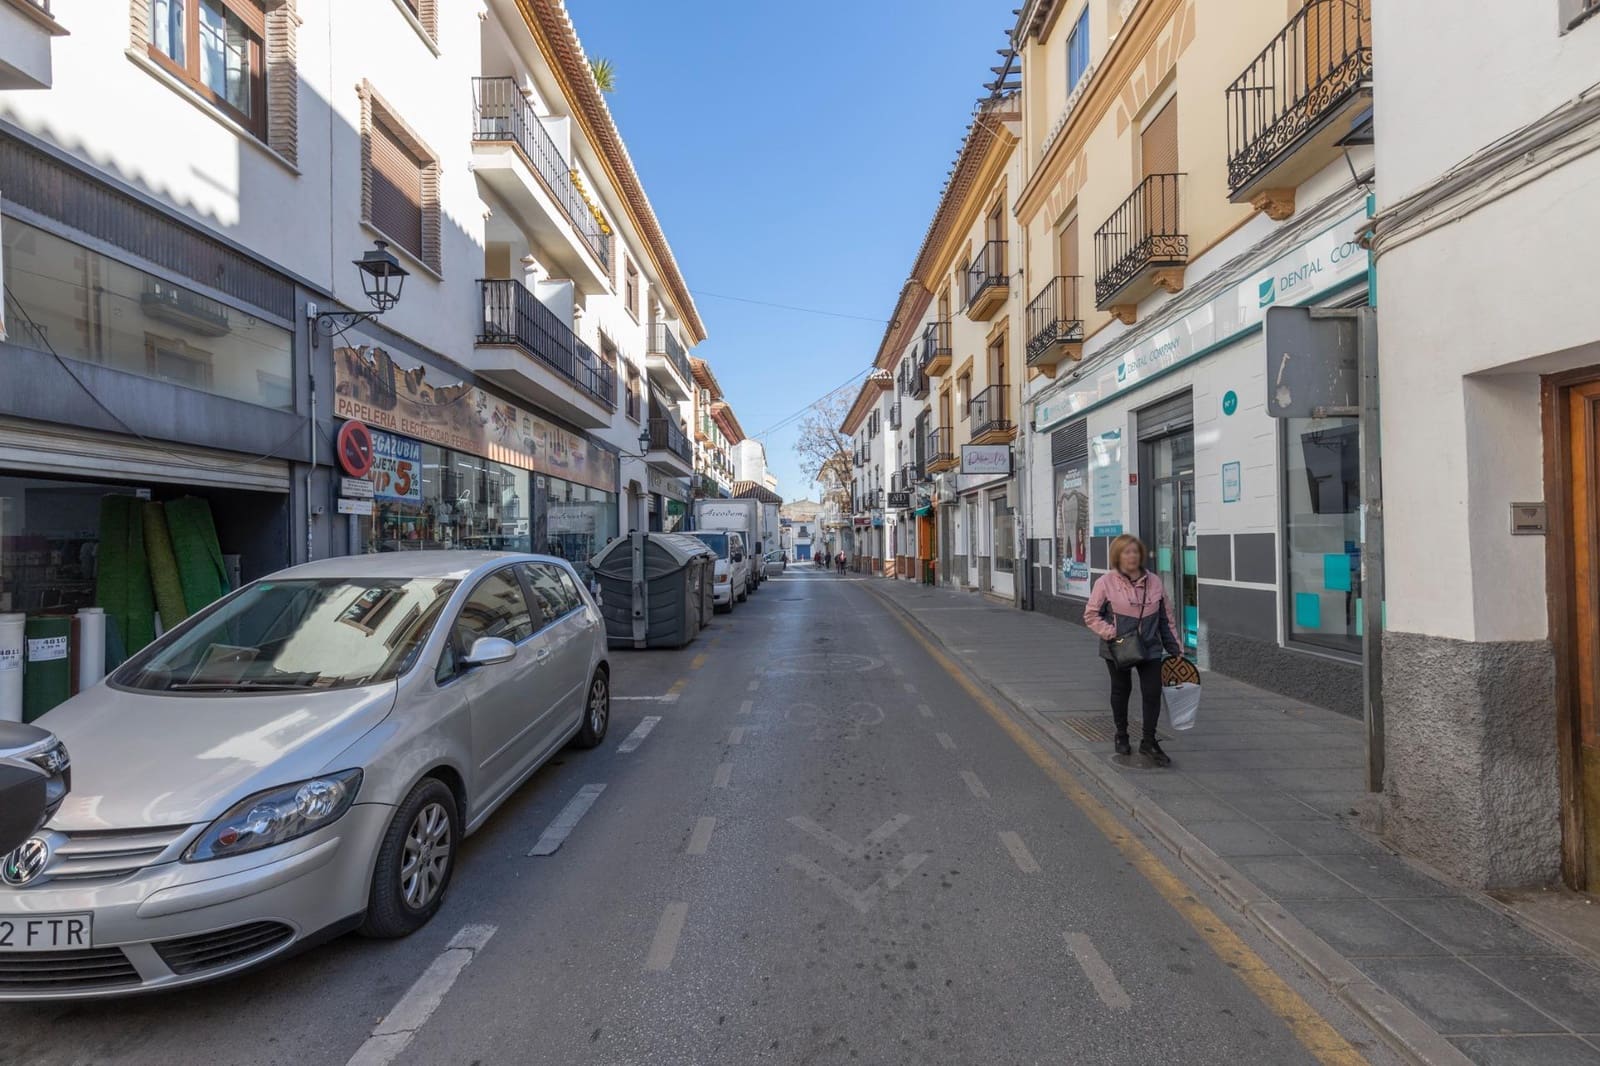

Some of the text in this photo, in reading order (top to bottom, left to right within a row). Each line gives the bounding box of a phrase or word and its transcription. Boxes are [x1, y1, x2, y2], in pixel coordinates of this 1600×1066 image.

[1281, 258, 1322, 291] DENTAL
[338, 399, 397, 429] PAPELERIA
[401, 418, 449, 443] ELECTRICIDAD
[371, 433, 420, 460] EGAZUBIA
[372, 455, 396, 472] RJETA
[394, 461, 412, 496] 5
[27, 919, 84, 946] FTR
